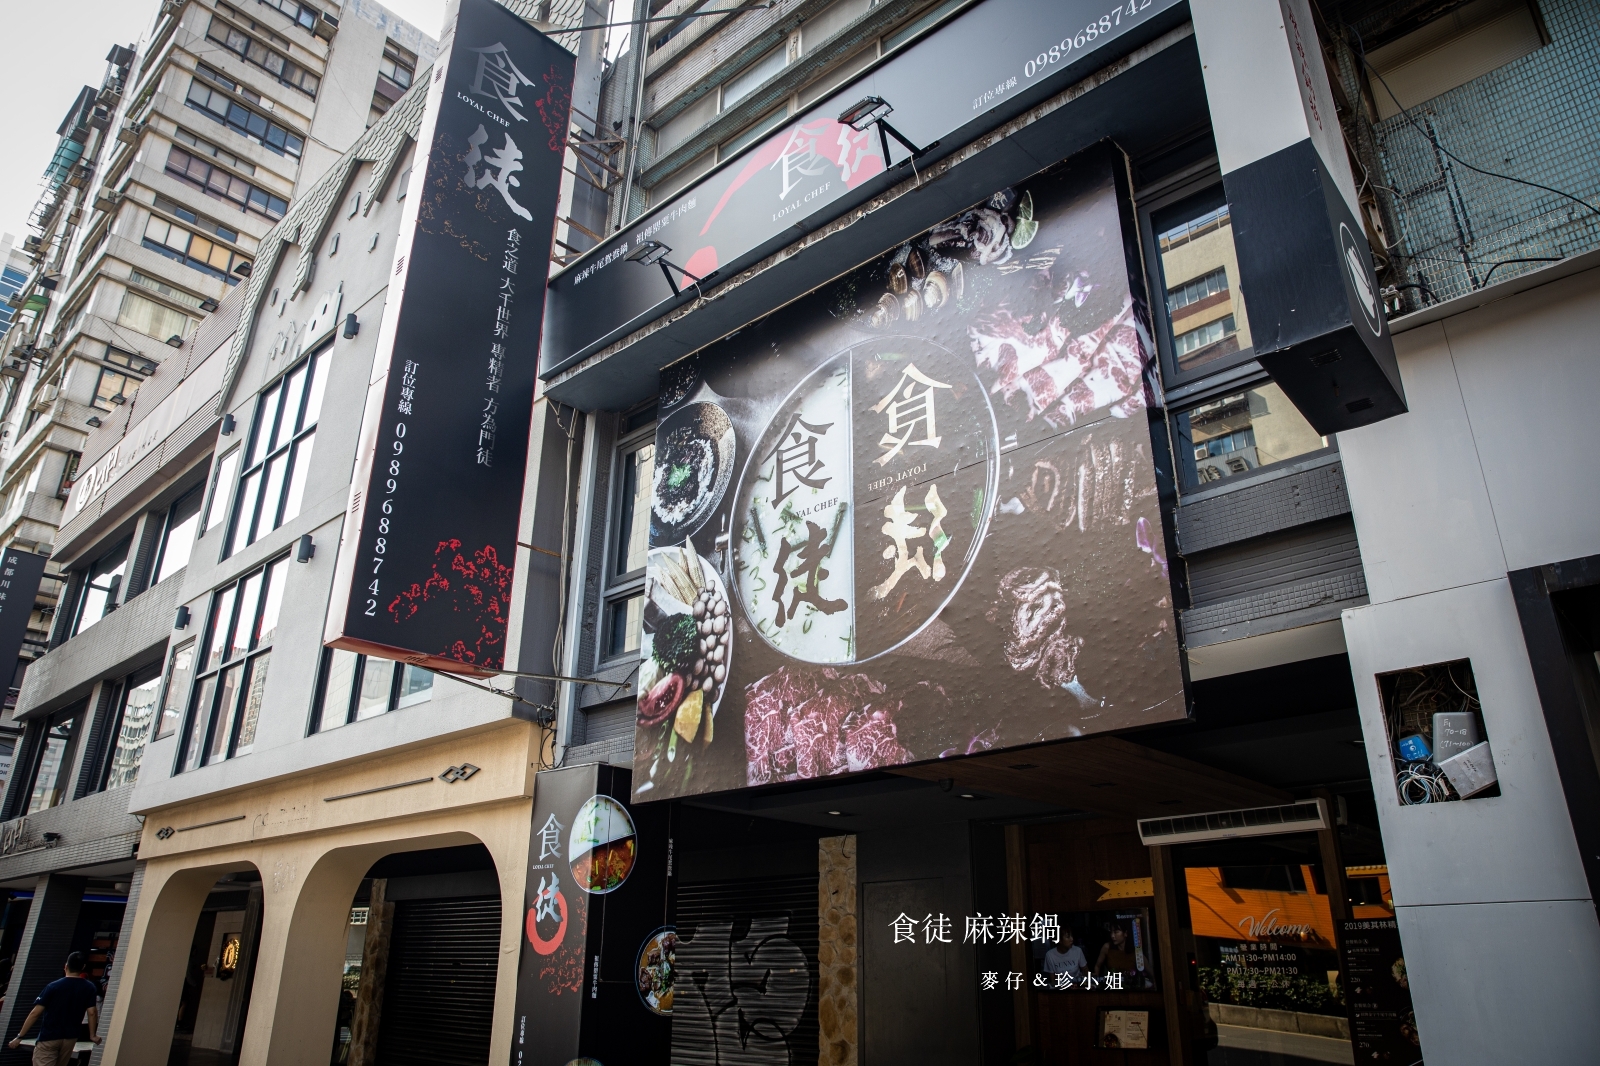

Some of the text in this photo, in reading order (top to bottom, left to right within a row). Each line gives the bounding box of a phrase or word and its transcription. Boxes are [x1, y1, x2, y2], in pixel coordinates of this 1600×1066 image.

[456, 91, 511, 128] LOYAL CHEF
[972, 76, 1017, 110] 訂位專線
[772, 181, 832, 222] LOYAL CHEF
[476, 227, 522, 468] 食之道 大千世界 專精者 方為門徒
[364, 359, 420, 617] 訂位專線 0989688742
[814, 497, 839, 513] CHEF
[0, 556, 18, 613] 成都川味
[1238, 908, 1311, 938] Welcome
[1225, 953, 1297, 962] AM11:30~PM14:00
[1227, 966, 1299, 975] PM17:30~PM21:30
